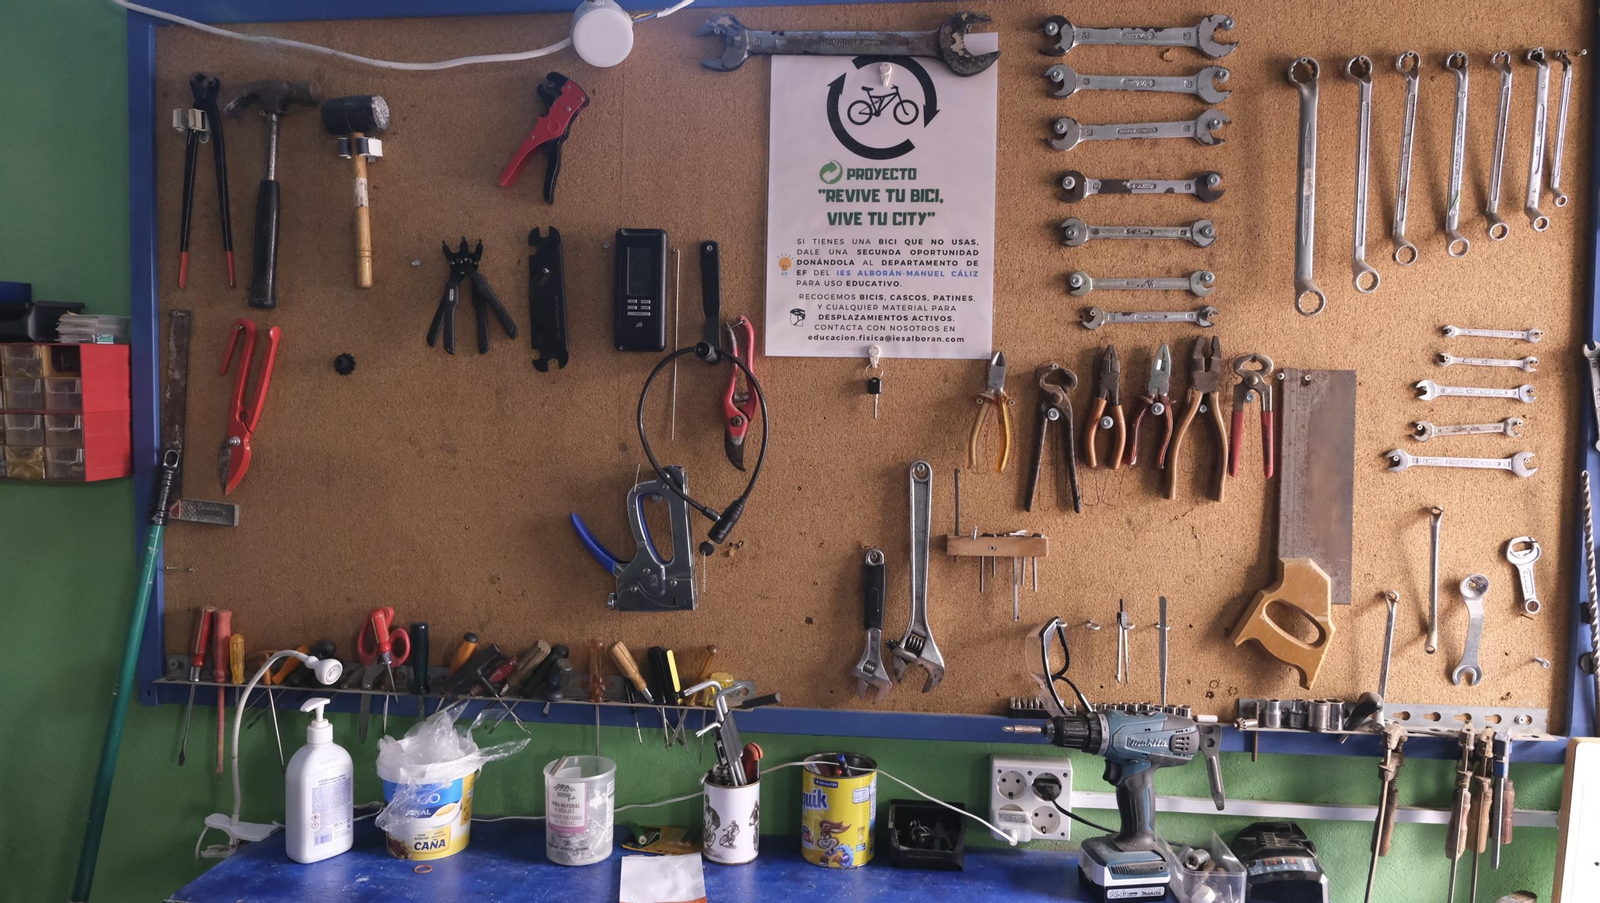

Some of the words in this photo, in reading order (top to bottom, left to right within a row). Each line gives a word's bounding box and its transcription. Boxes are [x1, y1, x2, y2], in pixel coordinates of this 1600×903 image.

[847, 168, 917, 180] PROYECTO
[885, 189, 905, 203] TU
[910, 189, 944, 204] BICI,
[827, 212, 862, 226] VIVE
[867, 212, 888, 226] TU
[857, 269, 945, 277] ALBORÁN-MANUEL
[951, 269, 978, 277] CÁLIZ
[808, 334, 964, 343] educacion.fisica@iesalboran.com
[414, 839, 446, 850] CAÑA
